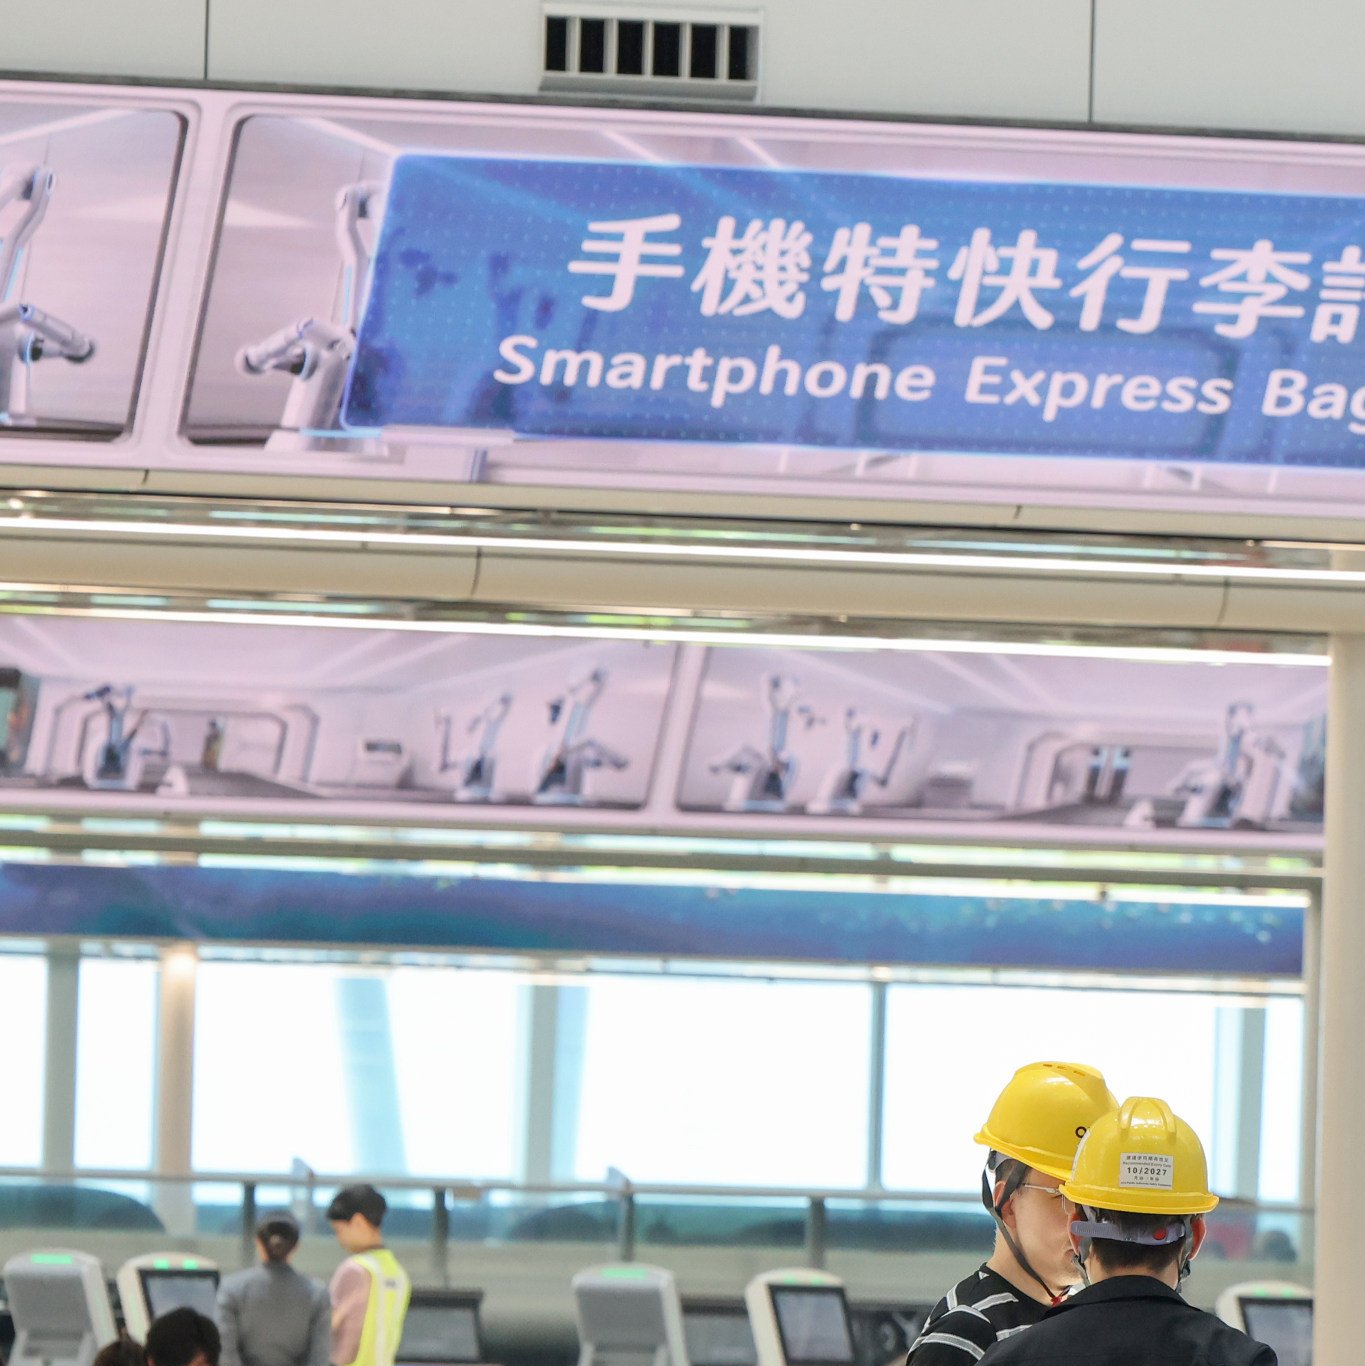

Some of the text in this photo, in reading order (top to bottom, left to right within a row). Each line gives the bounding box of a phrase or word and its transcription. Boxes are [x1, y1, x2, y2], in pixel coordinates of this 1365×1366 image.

[494, 335, 936, 408] Smartphone
[964, 355, 1234, 422] Express
[1127, 1166, 1167, 1176] 10/2027
